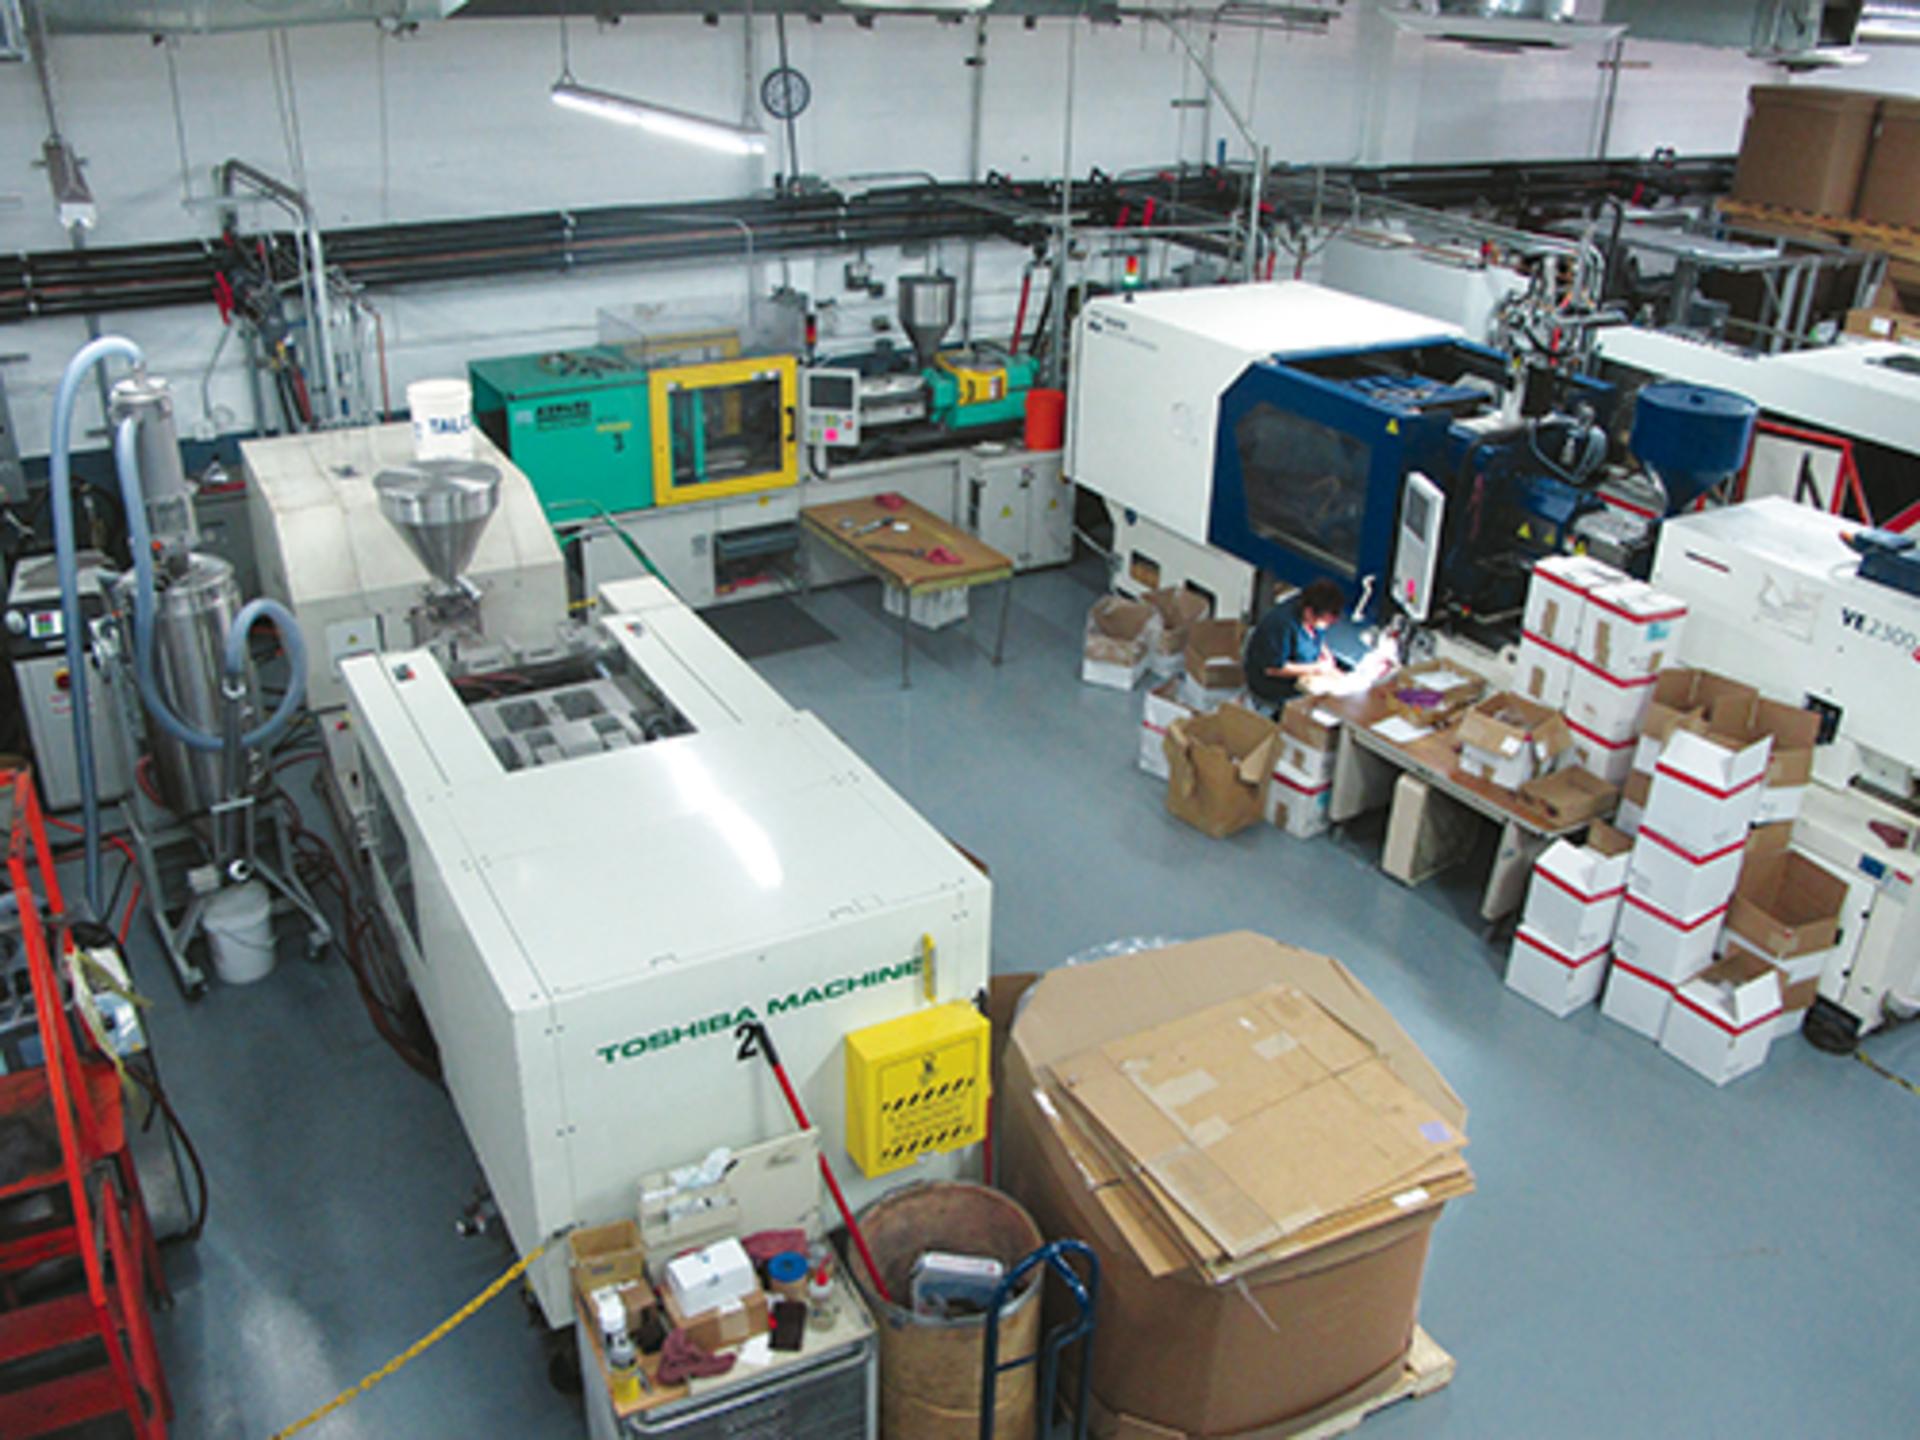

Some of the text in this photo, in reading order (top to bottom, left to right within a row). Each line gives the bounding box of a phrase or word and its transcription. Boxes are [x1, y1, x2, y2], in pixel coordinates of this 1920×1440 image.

[613, 431, 625, 453] 3
[597, 955, 923, 1063] TOSHIBA MACHINE
[735, 1021, 758, 1061] 2
